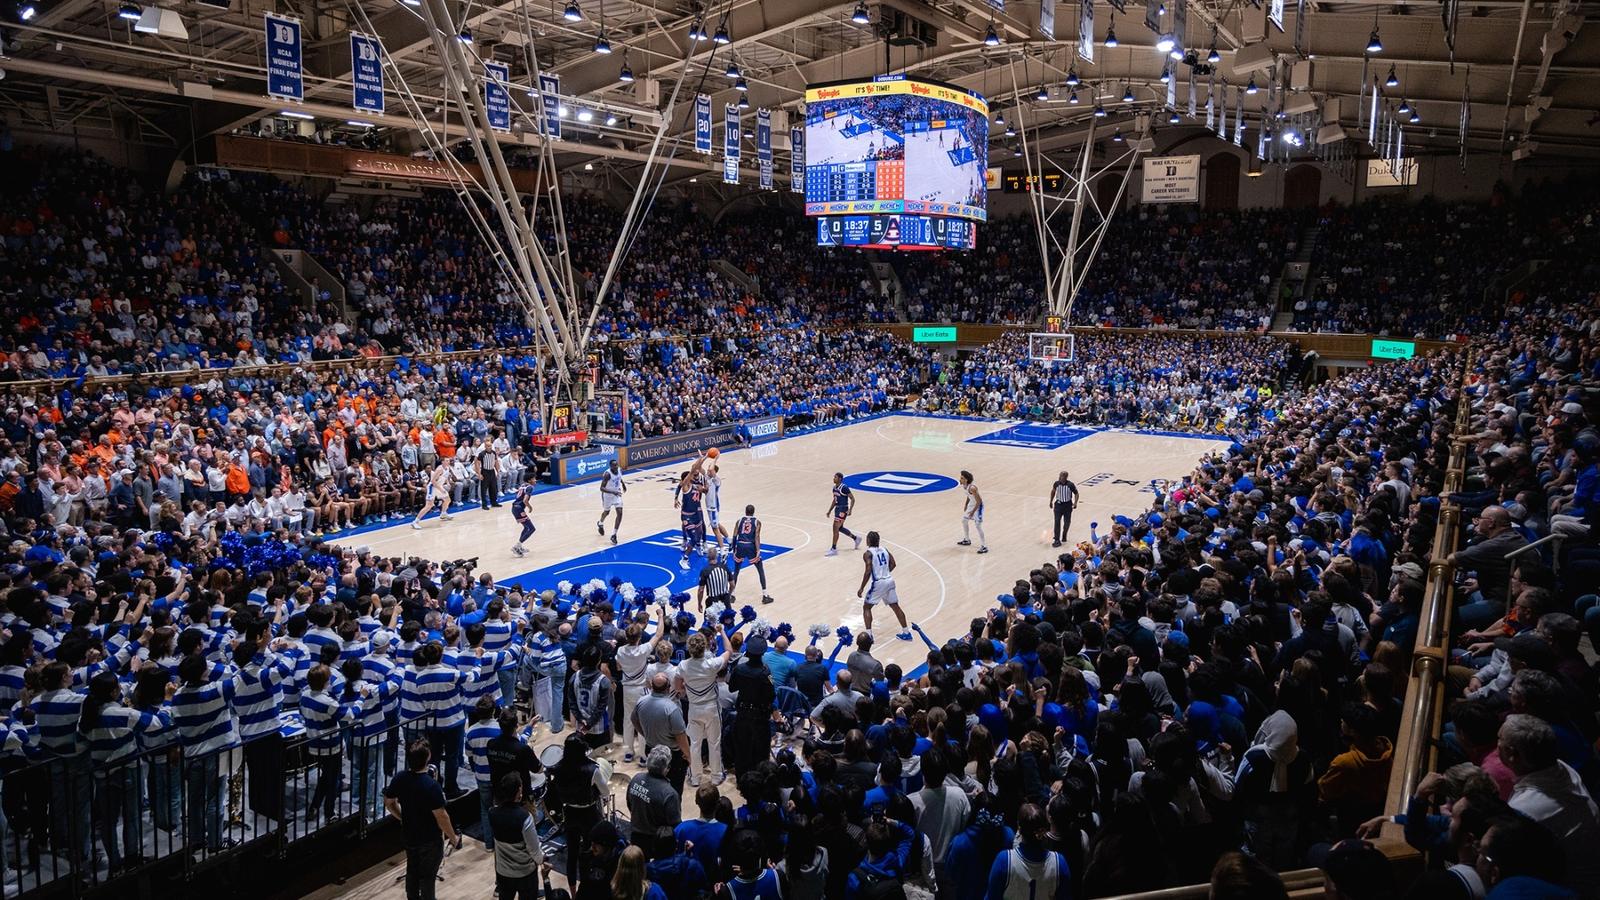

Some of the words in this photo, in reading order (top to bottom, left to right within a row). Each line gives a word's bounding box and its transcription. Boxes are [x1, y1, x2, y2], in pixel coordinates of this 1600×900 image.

[277, 48, 292, 57] NCAA
[272, 58, 298, 68] WOMEN'S
[270, 67, 285, 76] FINAL
[287, 70, 300, 78] FOUR
[358, 73, 379, 82] WOMEN'S
[698, 119, 708, 132] 20
[728, 128, 738, 140] 10
[762, 132, 766, 144] 1
[833, 221, 840, 232] 0
[845, 220, 869, 230] 18:37
[874, 220, 881, 230] 5
[938, 220, 944, 233] 0
[948, 222, 963, 232] 18:37
[965, 222, 968, 235] 5
[631, 446, 670, 460] CAMERON
[673, 440, 700, 453] INDOOR
[704, 434, 732, 445] STADIUM
[742, 522, 752, 534] 13
[877, 553, 887, 566] 14
[581, 690, 590, 707] 3
[633, 783, 649, 794] EVENT
[631, 788, 650, 803] SERVICES
